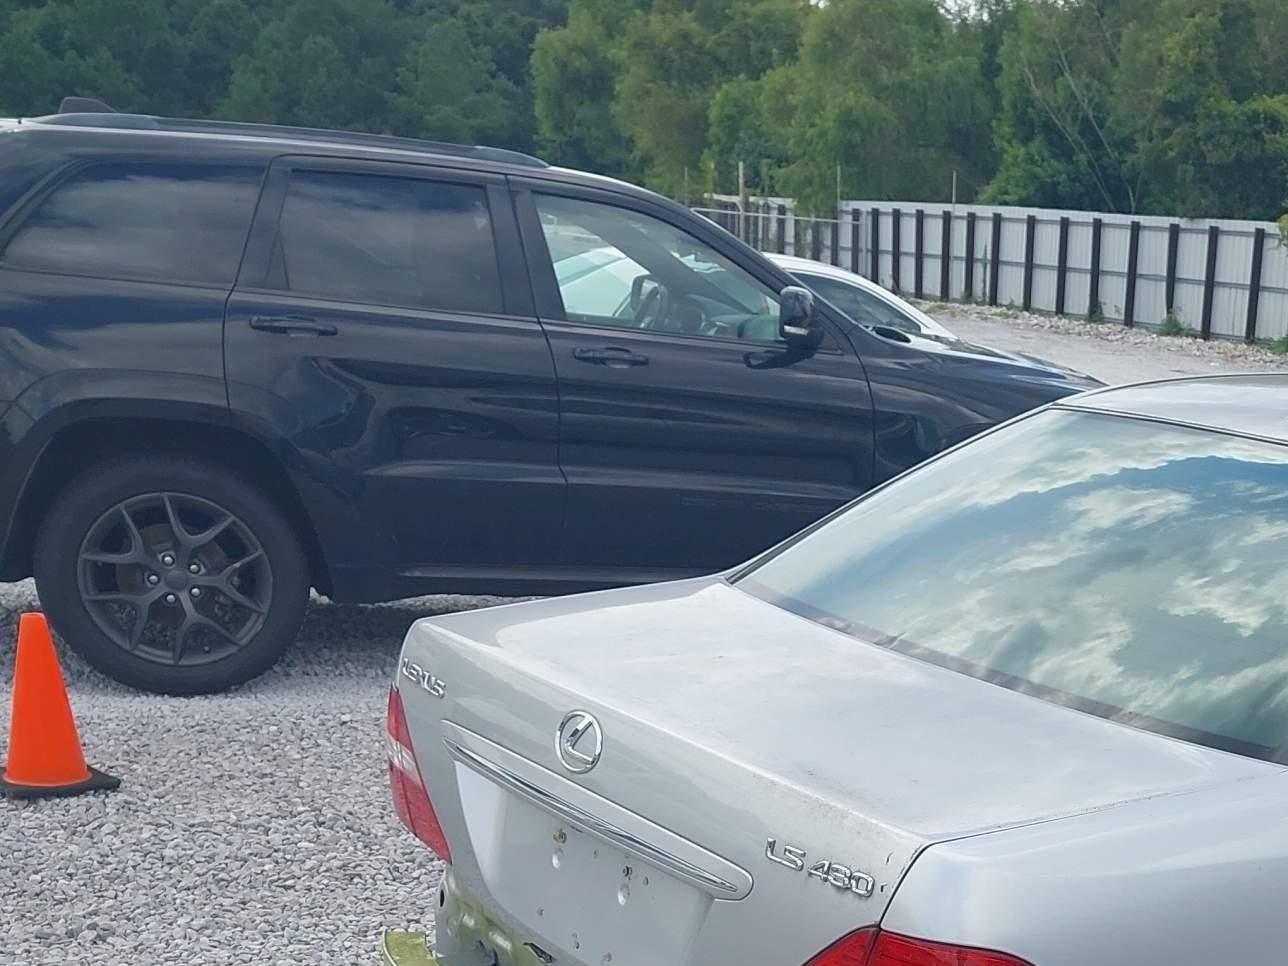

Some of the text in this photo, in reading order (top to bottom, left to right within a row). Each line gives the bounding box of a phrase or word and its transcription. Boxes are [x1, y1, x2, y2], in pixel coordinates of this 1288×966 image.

[402, 657, 446, 699] LEXUS
[766, 837, 875, 898] LS 430
